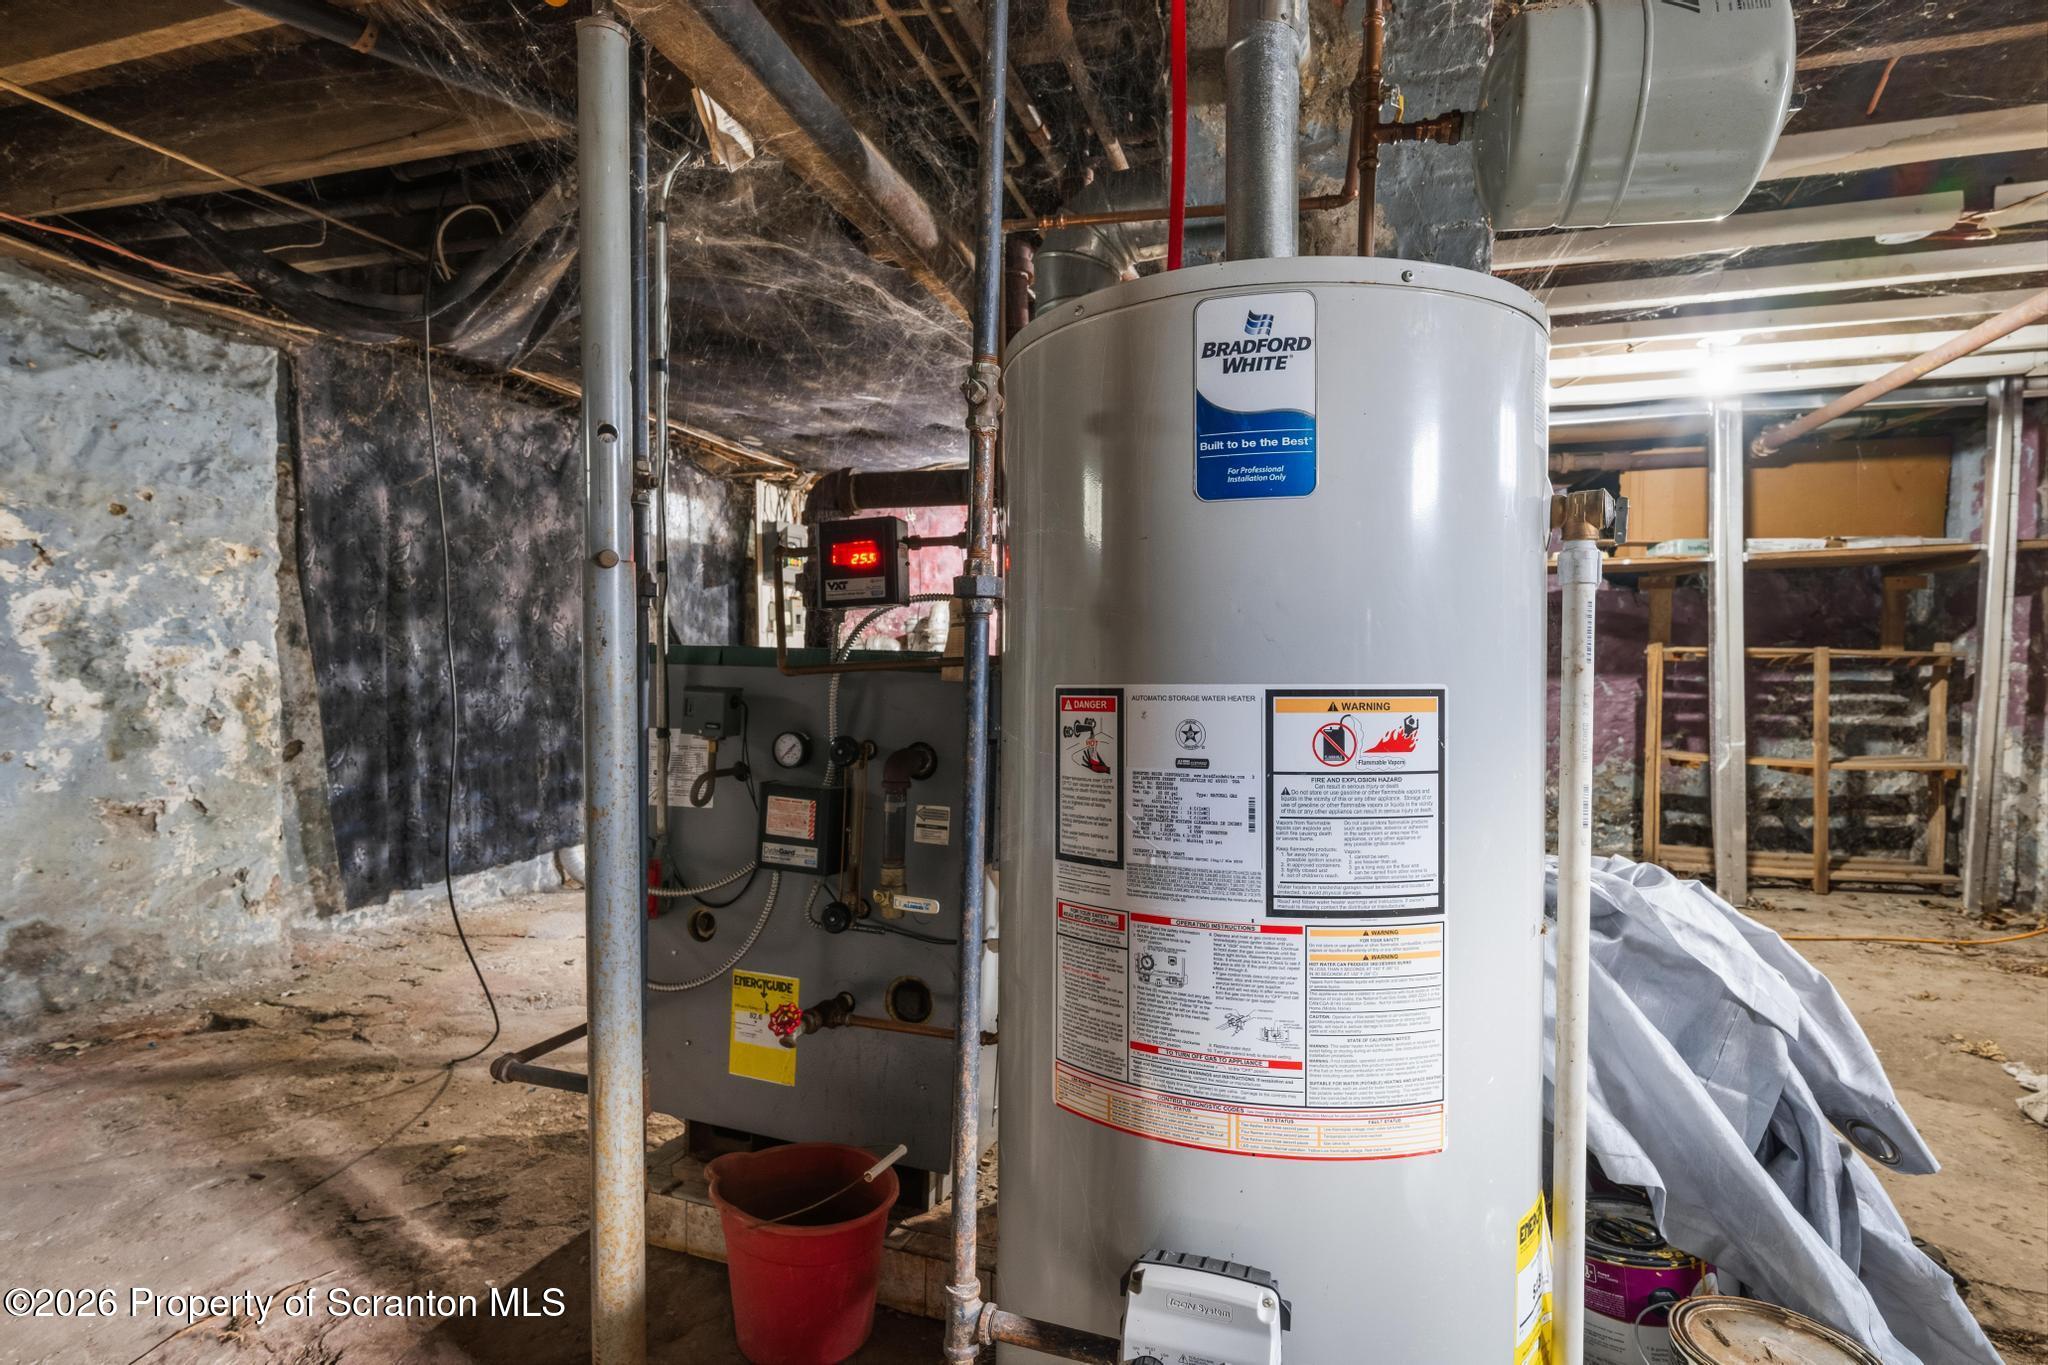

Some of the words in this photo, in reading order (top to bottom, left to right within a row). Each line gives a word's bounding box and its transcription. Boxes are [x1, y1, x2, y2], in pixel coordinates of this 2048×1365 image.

[1201, 336, 1312, 359] BRADFORD
[1222, 355, 1288, 374] WHITE
[1200, 442, 1224, 451] Built
[1227, 440, 1238, 450] to
[1242, 438, 1256, 448] be
[1260, 438, 1278, 447] the
[1228, 467, 1239, 475] For
[1240, 466, 1284, 474] Professional
[1227, 475, 1268, 483] Installation
[1270, 474, 1286, 482] Only
[828, 581, 848, 590] VXT
[1074, 700, 1107, 710] DANGER
[1342, 702, 1390, 710] WARNING
[1176, 920, 1209, 928] OPERATING
[1211, 922, 1256, 931] INSTRUCTIONS
[734, 975, 793, 994] ENERGYGUIDE
[1198, 1302, 1231, 1319] System
